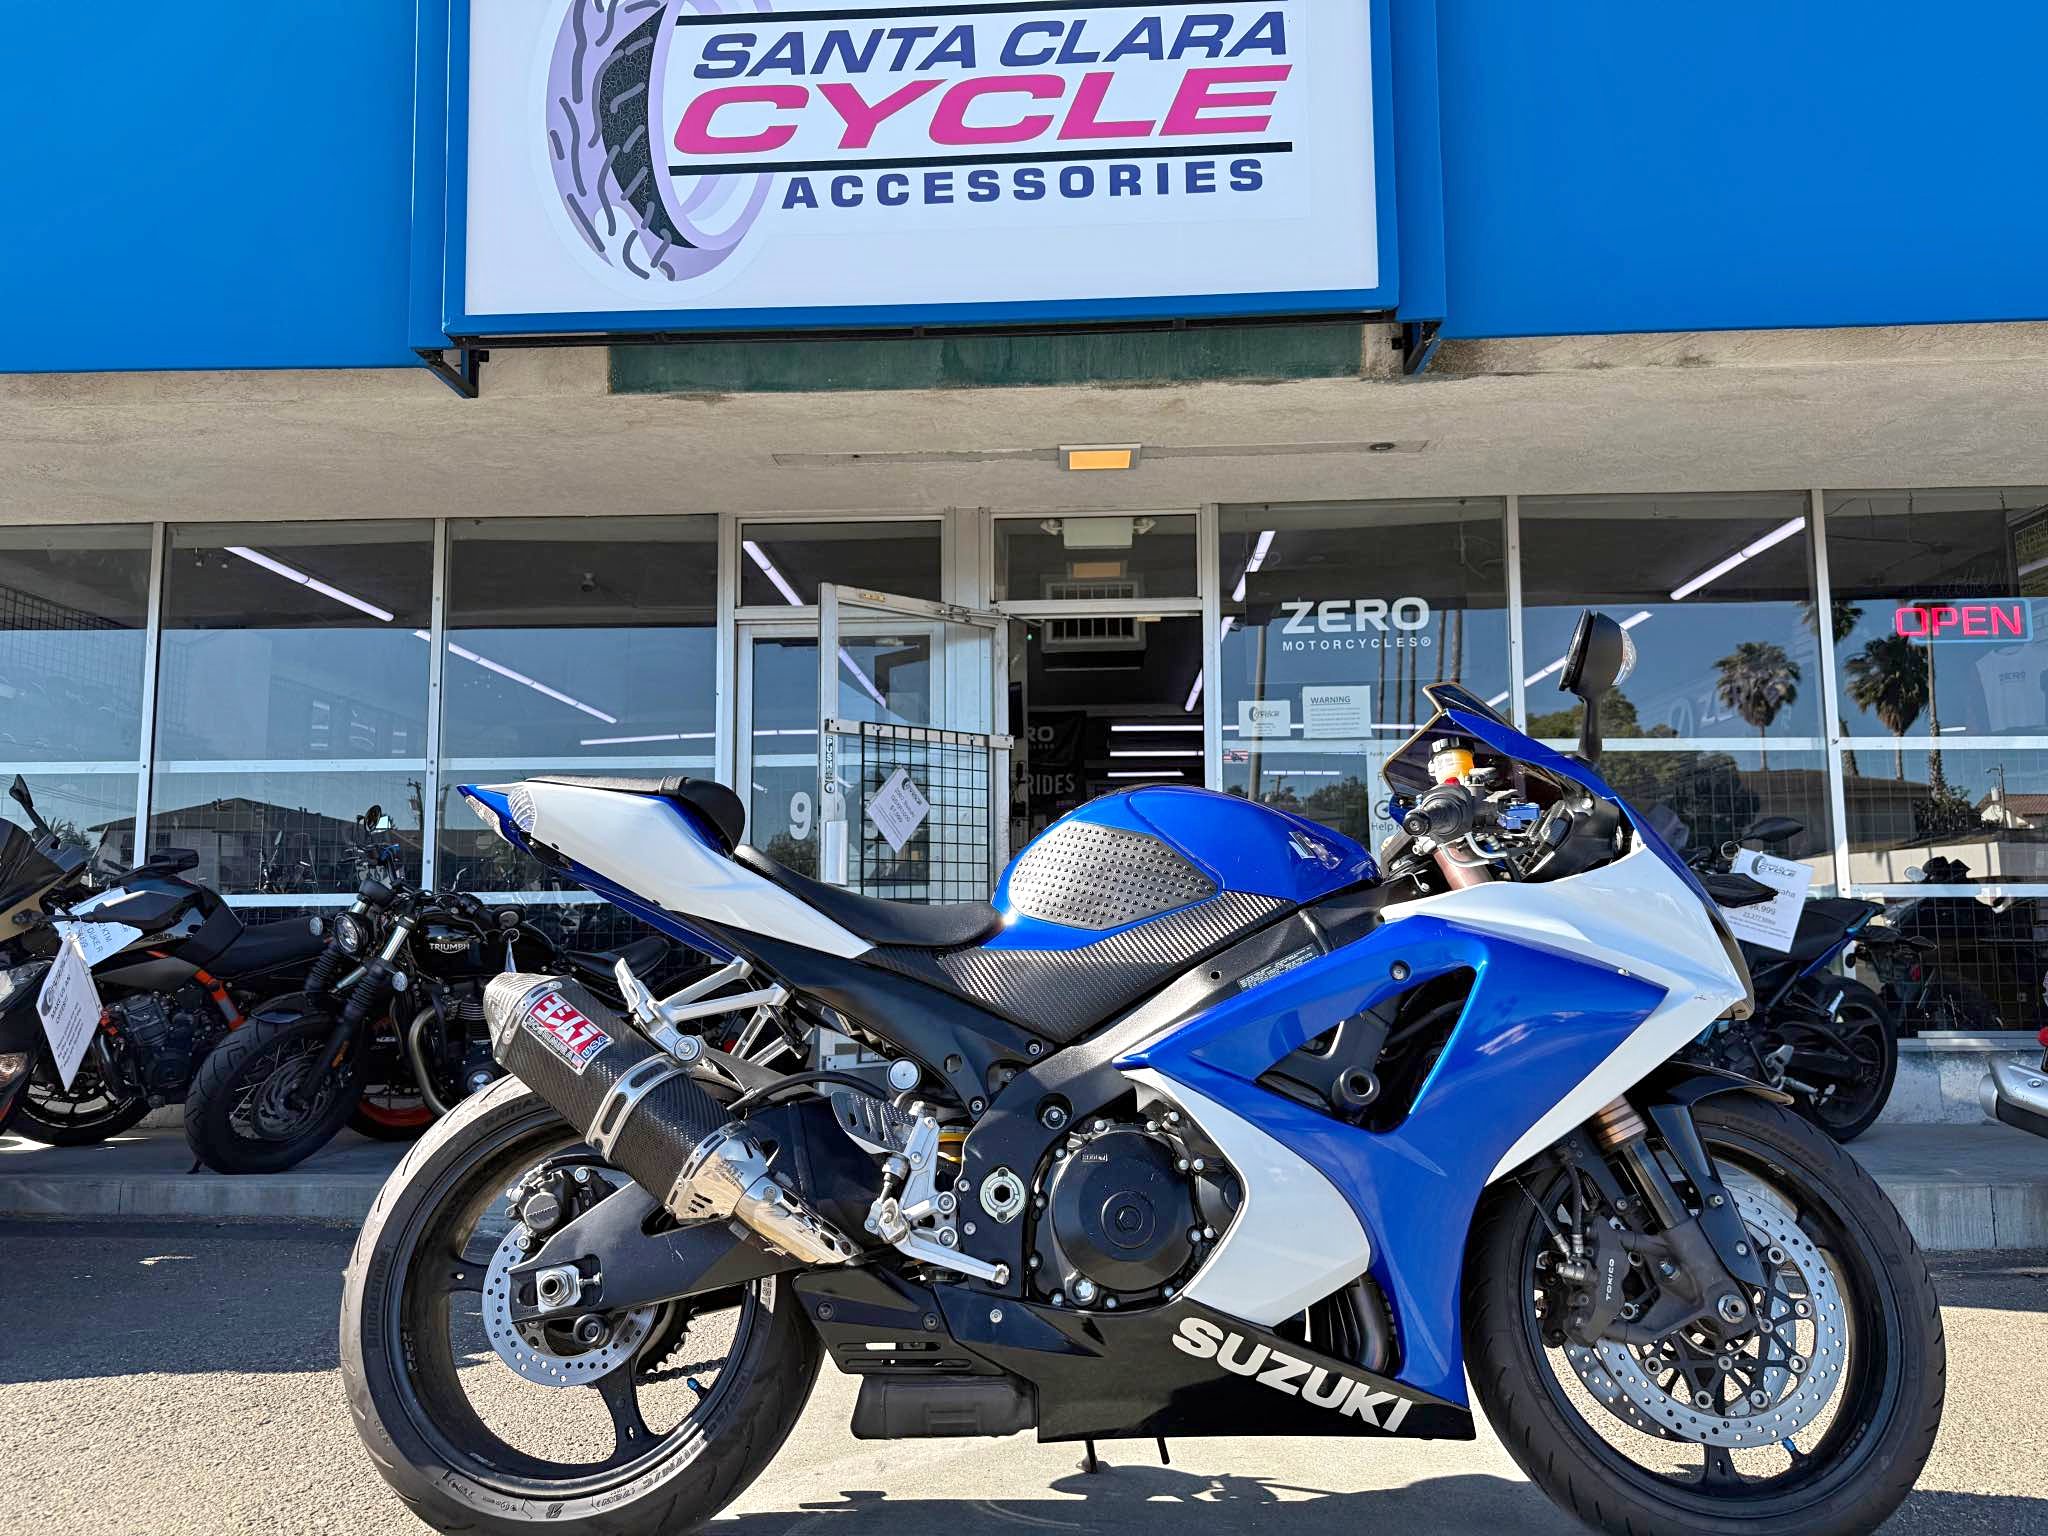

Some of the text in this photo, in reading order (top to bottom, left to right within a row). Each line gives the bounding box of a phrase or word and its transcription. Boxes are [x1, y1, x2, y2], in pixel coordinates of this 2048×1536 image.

[694, 11, 1288, 79] SANTA CLARA
[674, 65, 1292, 154] CYCLE
[782, 158, 1263, 210] ACCESSORIES
[1281, 597, 1430, 634] ZERO
[1896, 606, 2022, 637] OPEN
[1310, 695, 1351, 705] WARNING
[1027, 726, 1054, 742] RO
[1371, 822, 1394, 832] Help
[429, 943, 470, 952] TRIUMPH
[581, 1035, 609, 1059] USA
[1605, 1258, 1614, 1300] TOKICO
[1172, 1316, 1413, 1433] SUZUKI
